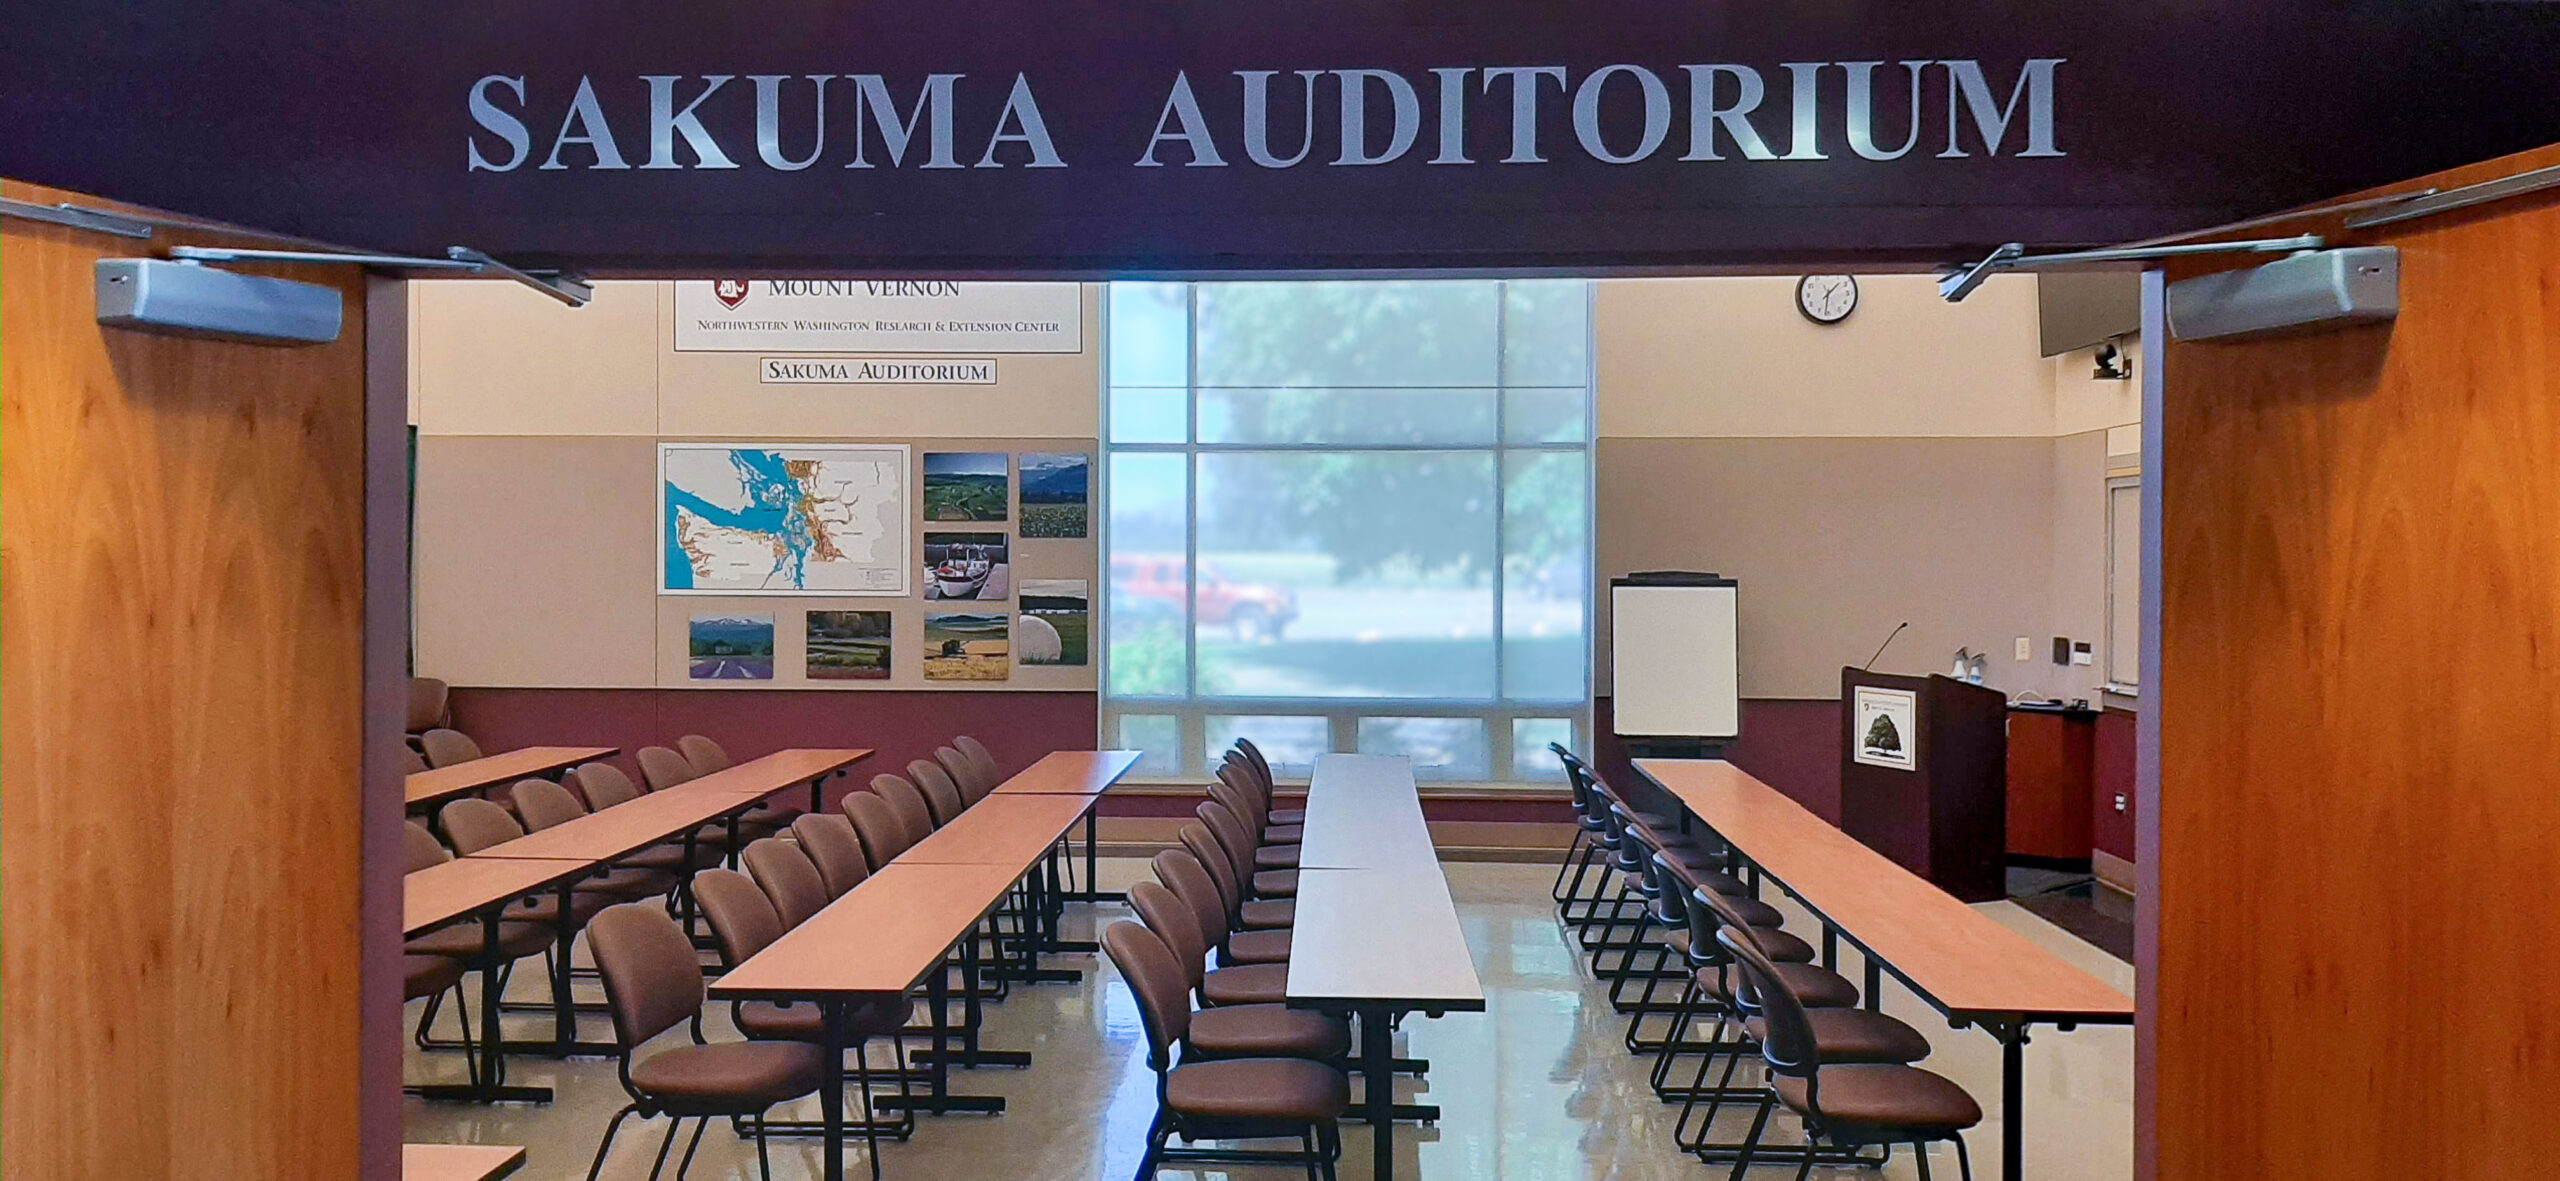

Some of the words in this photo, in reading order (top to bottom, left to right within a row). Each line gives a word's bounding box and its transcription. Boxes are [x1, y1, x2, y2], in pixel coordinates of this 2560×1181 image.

[468, 73, 1069, 172] SAKUMA
[1132, 57, 2068, 169] AUDITORIUM
[768, 280, 857, 297] MOUNT
[866, 280, 960, 297] VERNON
[697, 319, 789, 331] NORTHWESTERN
[793, 319, 870, 331] WASHINGTON
[875, 320, 932, 332] RESEARCH
[935, 321, 946, 332] &
[949, 320, 1012, 332] EXTENSION
[1014, 320, 1060, 333] CENTER
[768, 360, 849, 380] SAKUMA
[857, 361, 988, 381] AUDITORIUM
